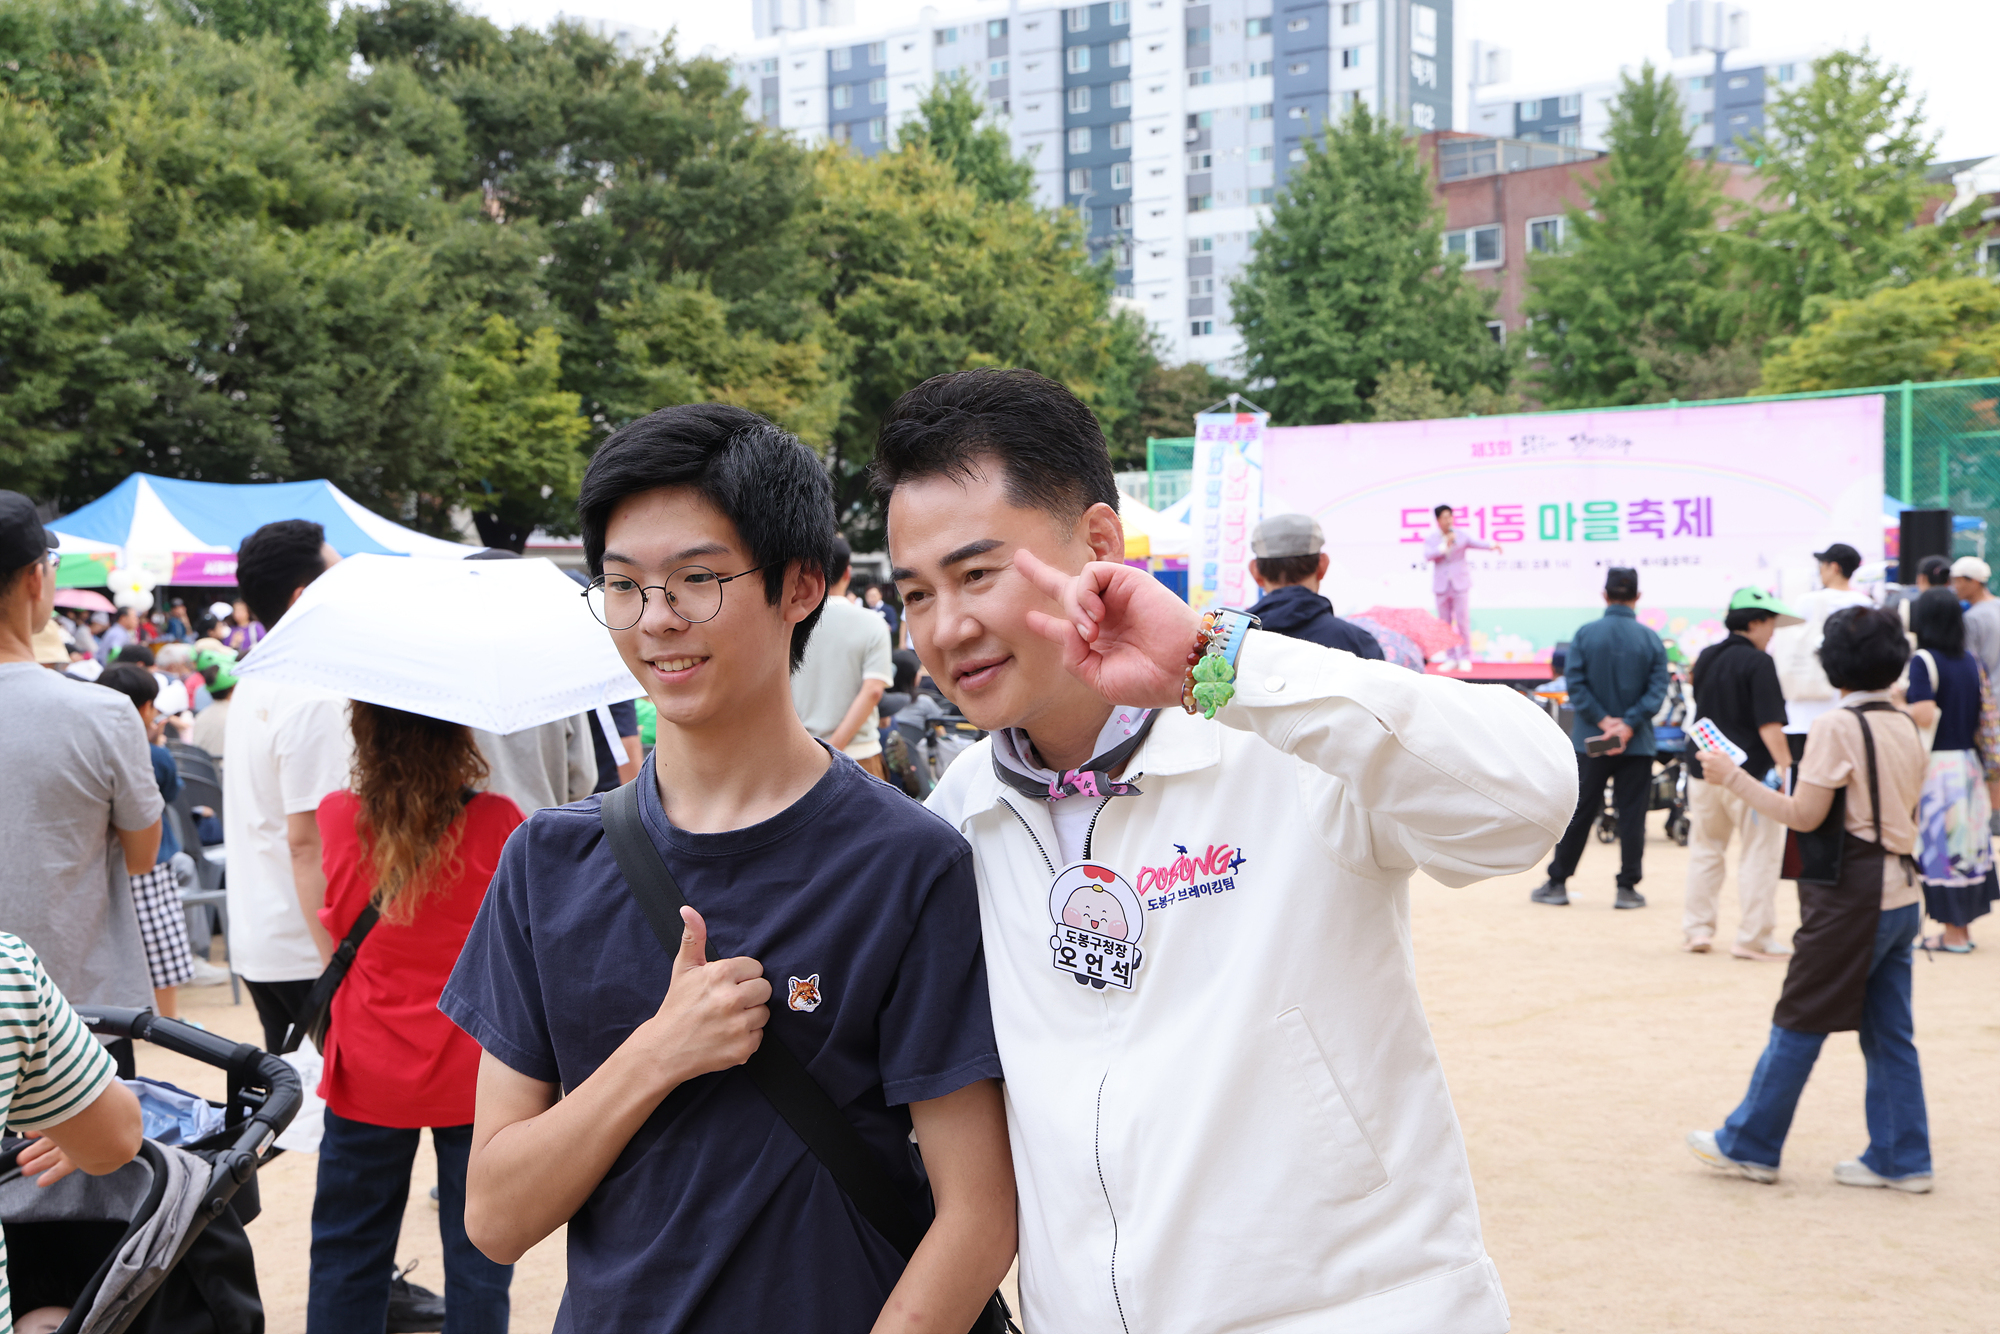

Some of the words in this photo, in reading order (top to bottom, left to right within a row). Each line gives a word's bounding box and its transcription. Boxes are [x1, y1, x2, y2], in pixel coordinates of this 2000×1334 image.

[1136, 844, 1235, 896] DOBONG
[1147, 893, 1176, 912] 도봉구
[1064, 929, 1128, 959] 도봉구청장
